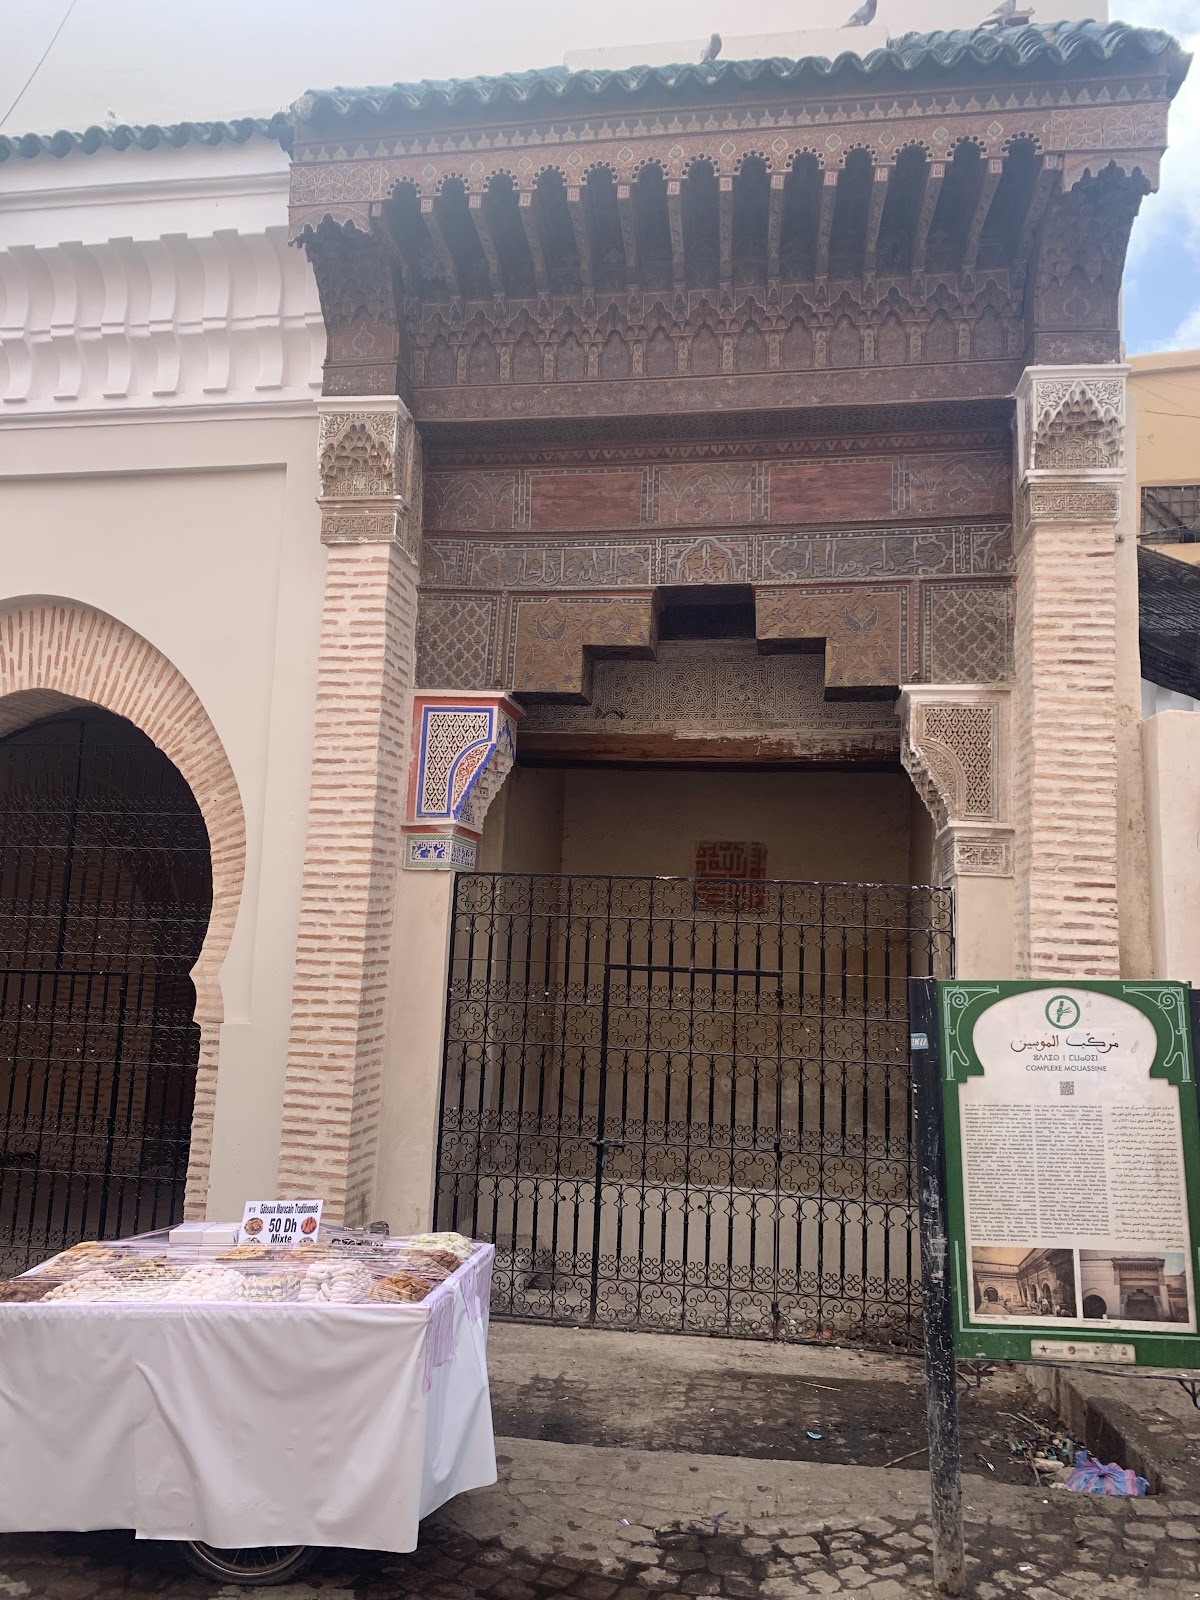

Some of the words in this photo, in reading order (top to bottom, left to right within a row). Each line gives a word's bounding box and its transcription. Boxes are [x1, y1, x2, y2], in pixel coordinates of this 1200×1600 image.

[276, 1203, 294, 1214] Marocain
[268, 1217, 282, 1233] 50
[283, 1217, 297, 1233] Dh
[270, 1233, 292, 1243] Mixte
